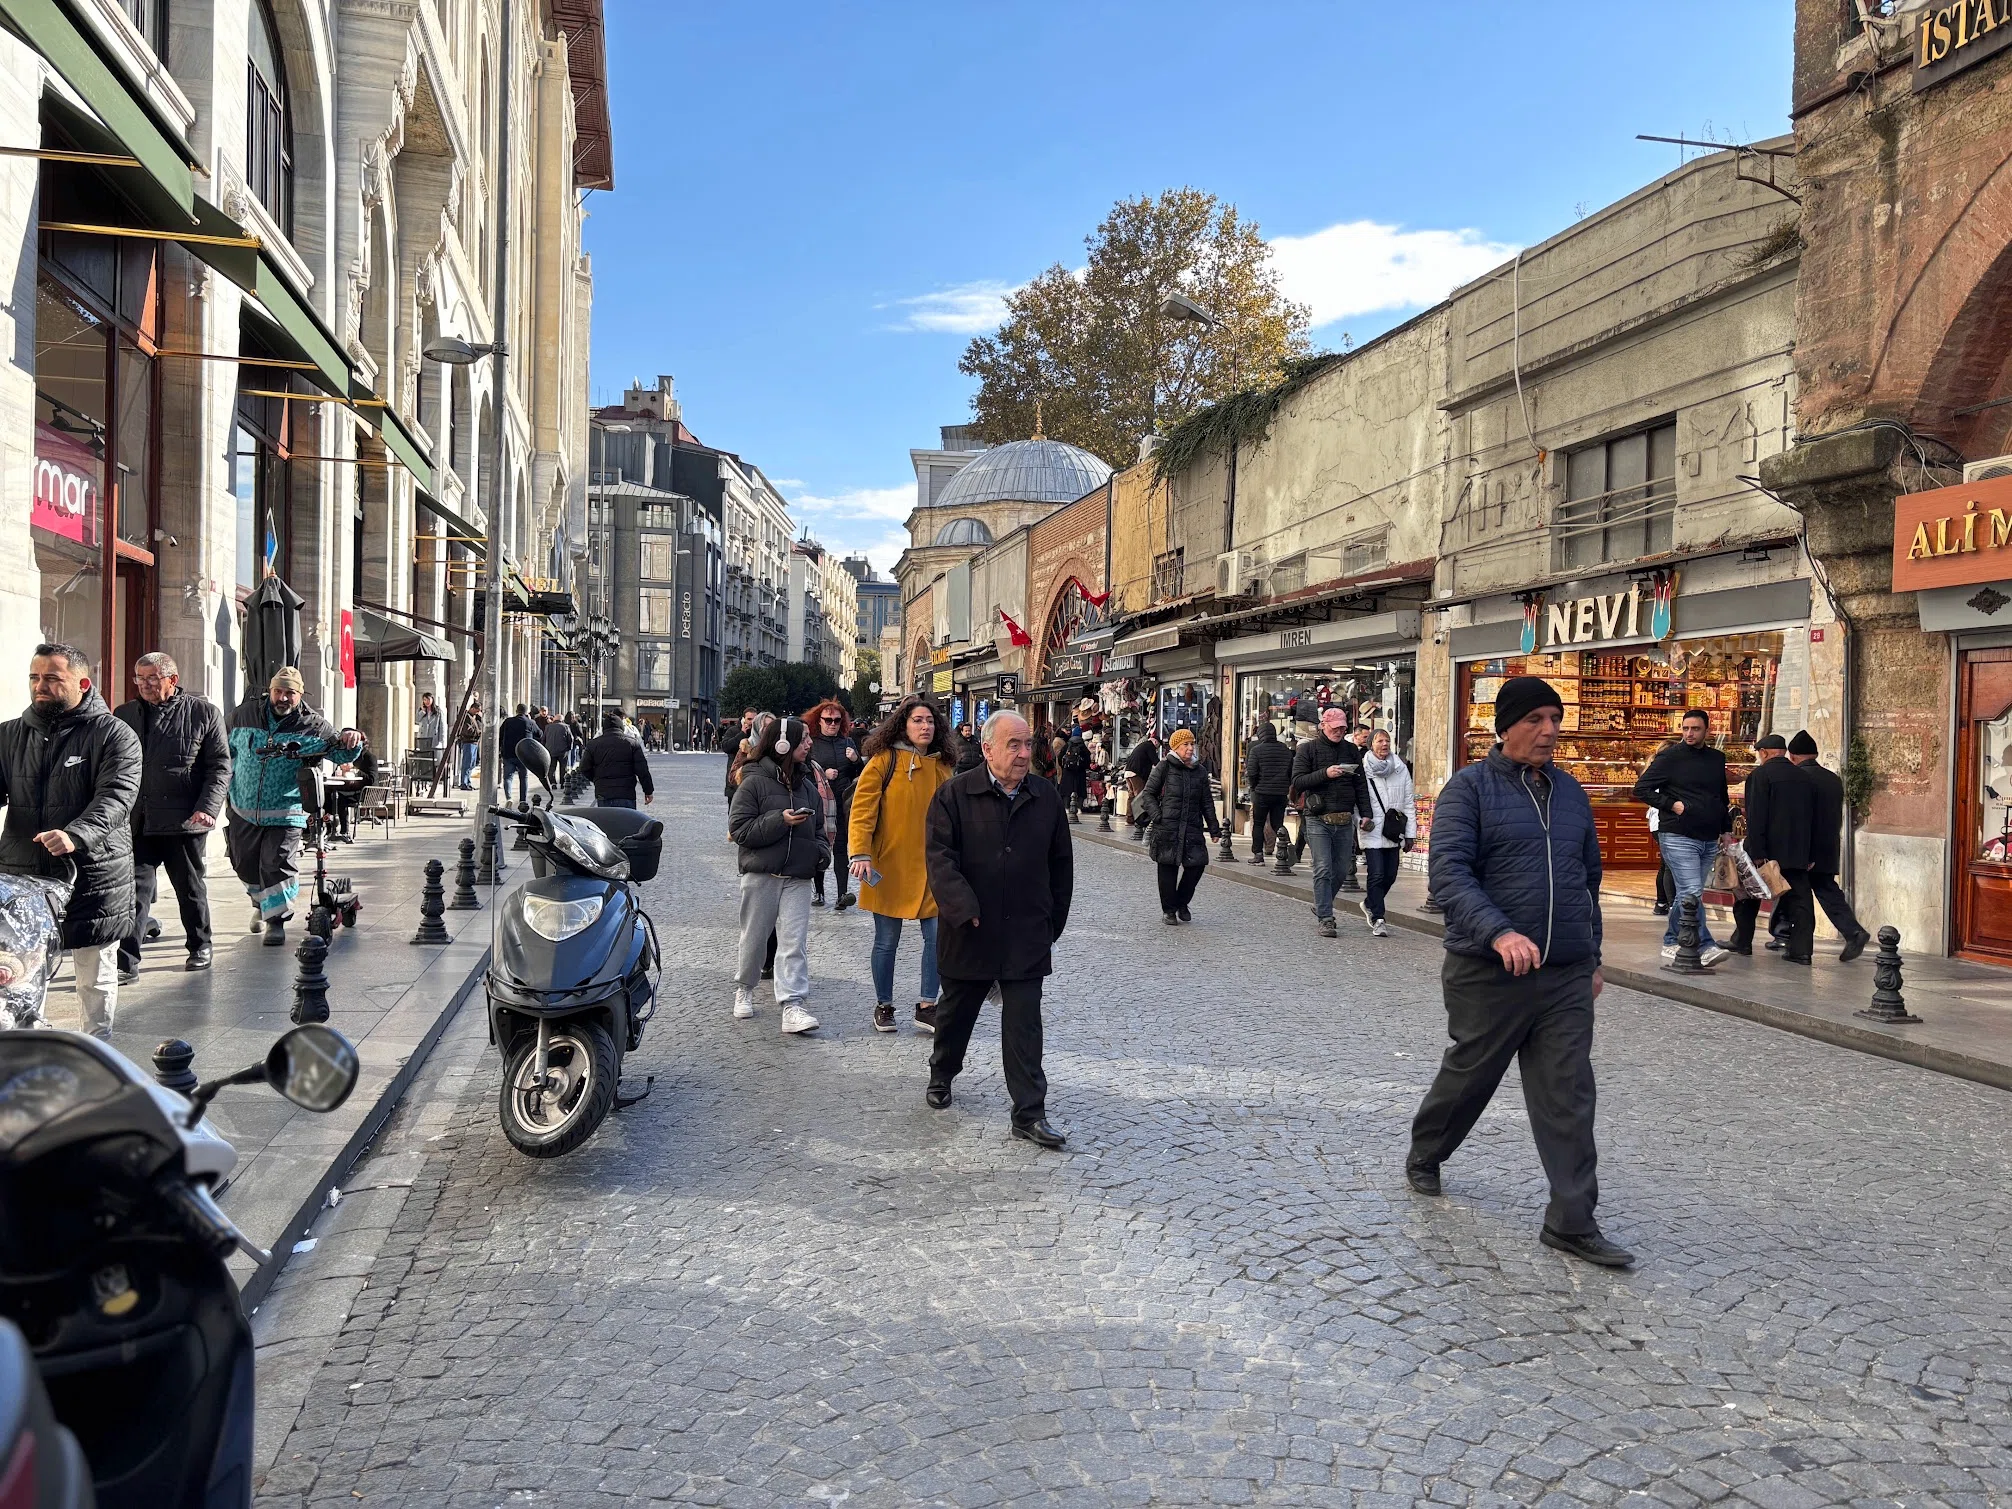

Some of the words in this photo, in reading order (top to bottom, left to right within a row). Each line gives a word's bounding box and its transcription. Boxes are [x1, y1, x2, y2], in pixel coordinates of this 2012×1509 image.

[1906, 501, 1977, 560] ALİ
[681, 591, 691, 639] DeFacto
[1545, 582, 1639, 626] NEVİ
[636, 699, 665, 708] DeFact
